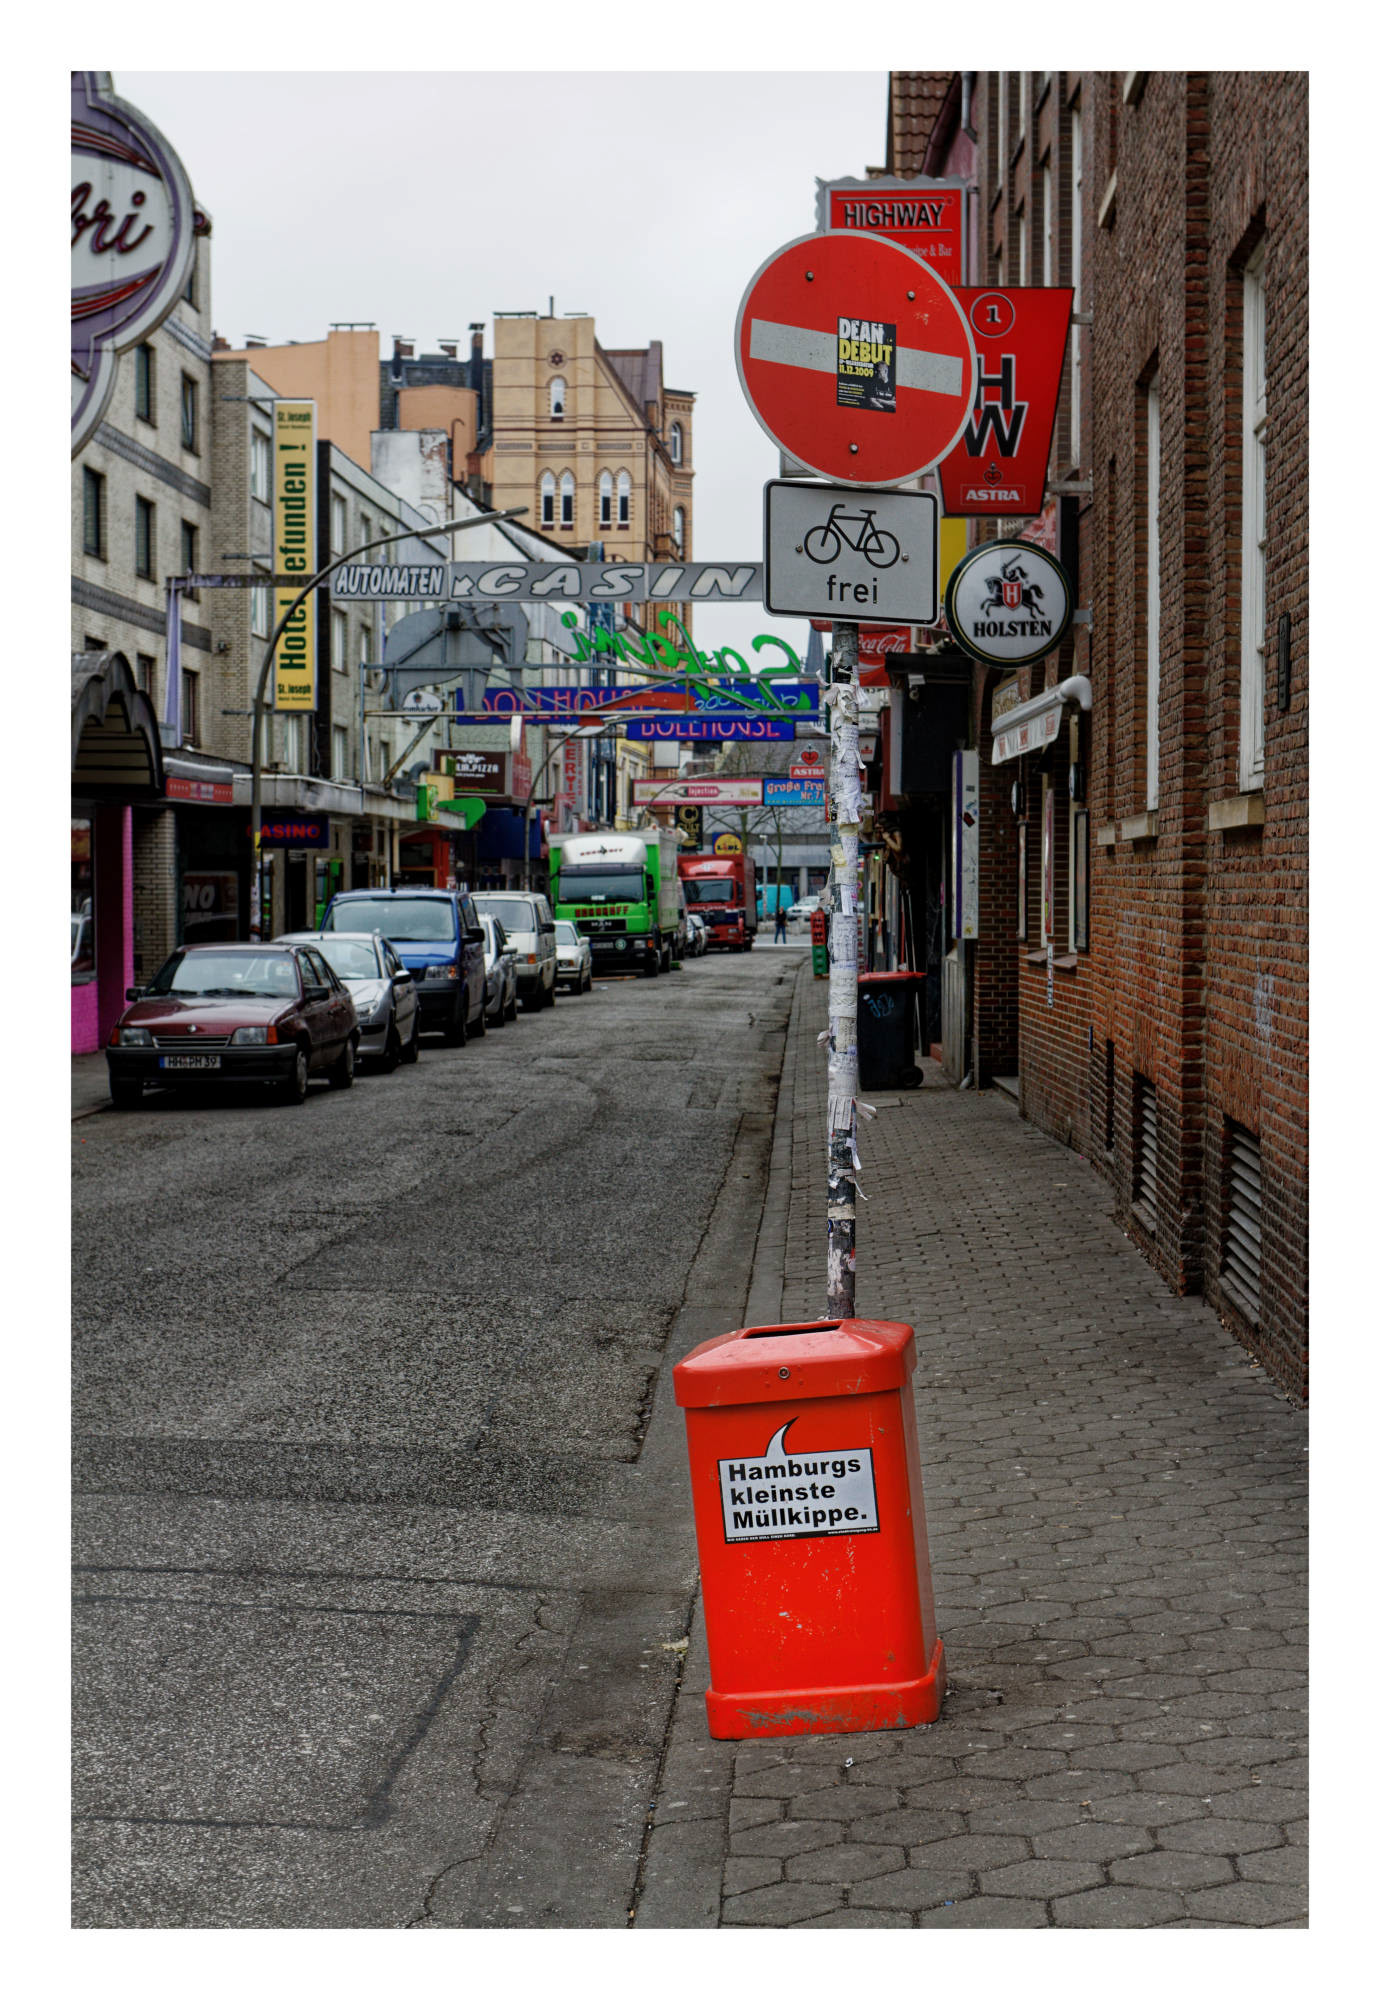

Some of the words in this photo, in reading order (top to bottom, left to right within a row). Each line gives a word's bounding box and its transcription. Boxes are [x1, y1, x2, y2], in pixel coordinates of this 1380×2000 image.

[844, 202, 944, 227] HIGHWAY
[839, 317, 885, 345] DEAN
[839, 338, 893, 366] DEBUT
[965, 489, 1020, 502] ASTRA
[280, 463, 306, 572] efunden
[336, 565, 444, 595] AUTOMATEN
[826, 575, 878, 604] frei
[280, 600, 306, 670] Hotel
[973, 620, 1052, 638] HOLSTEN
[728, 1459, 861, 1481] Hamburgs
[730, 1482, 835, 1505] kleinste
[733, 1506, 867, 1529] Müllkippe.
